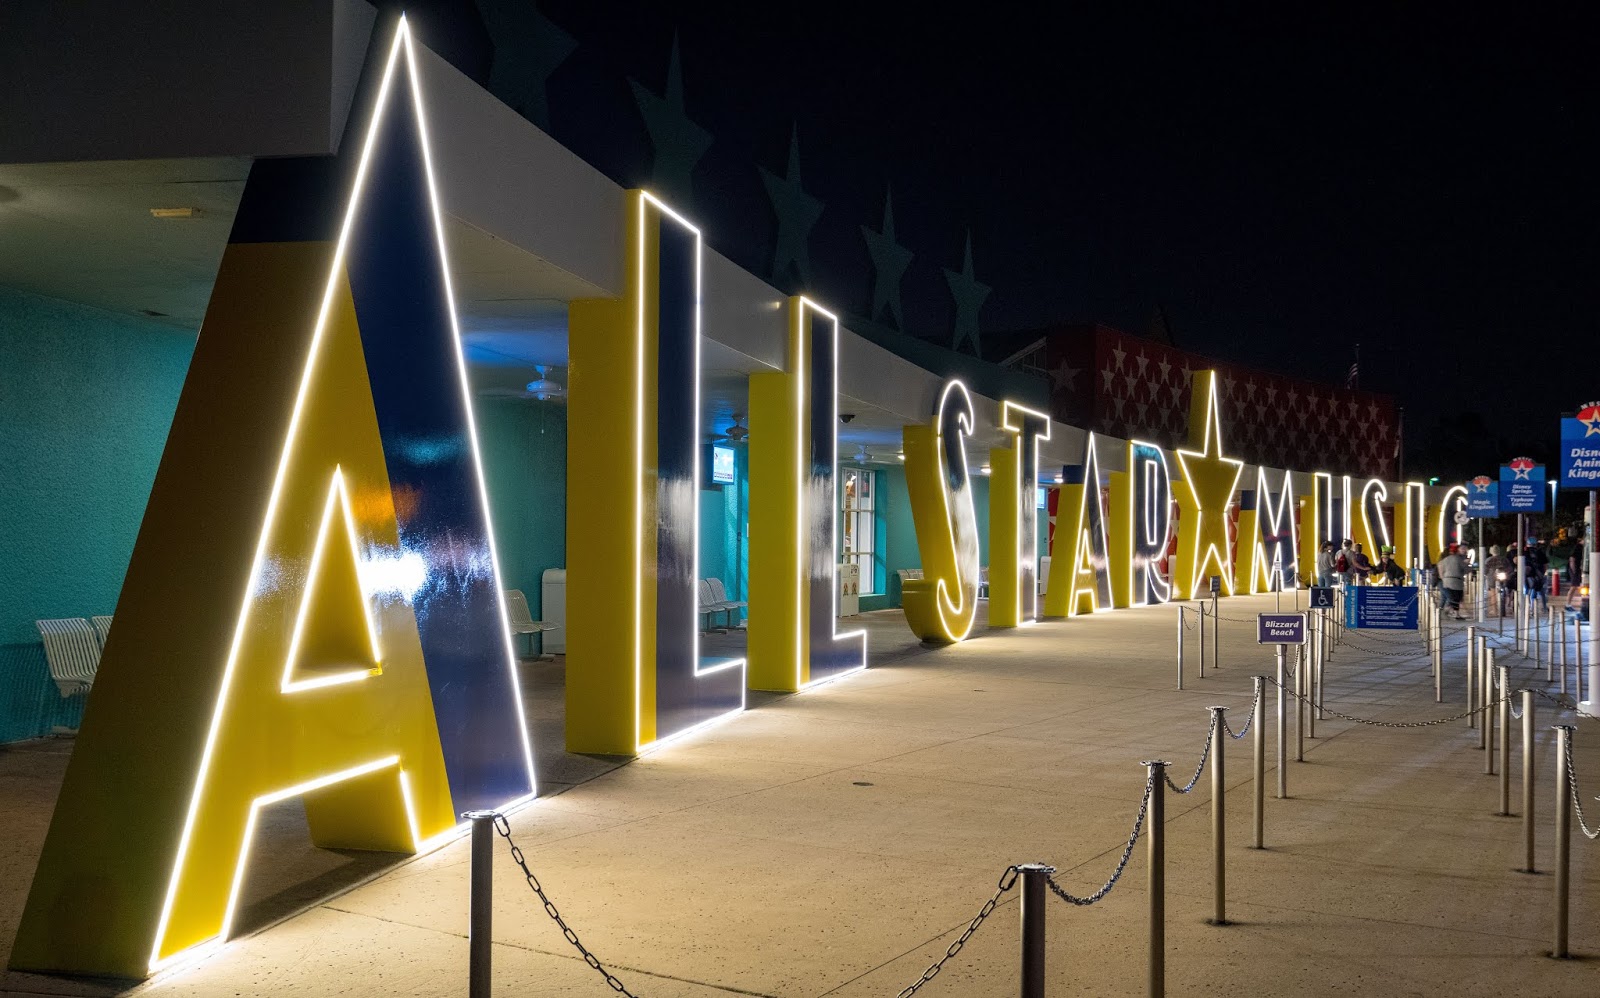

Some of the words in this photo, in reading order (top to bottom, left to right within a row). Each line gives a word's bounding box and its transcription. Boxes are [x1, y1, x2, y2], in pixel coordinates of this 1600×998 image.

[148, 13, 868, 977] ALL
[936, 378, 1172, 643] STAR
[1250, 464, 1475, 595] MUSIC
